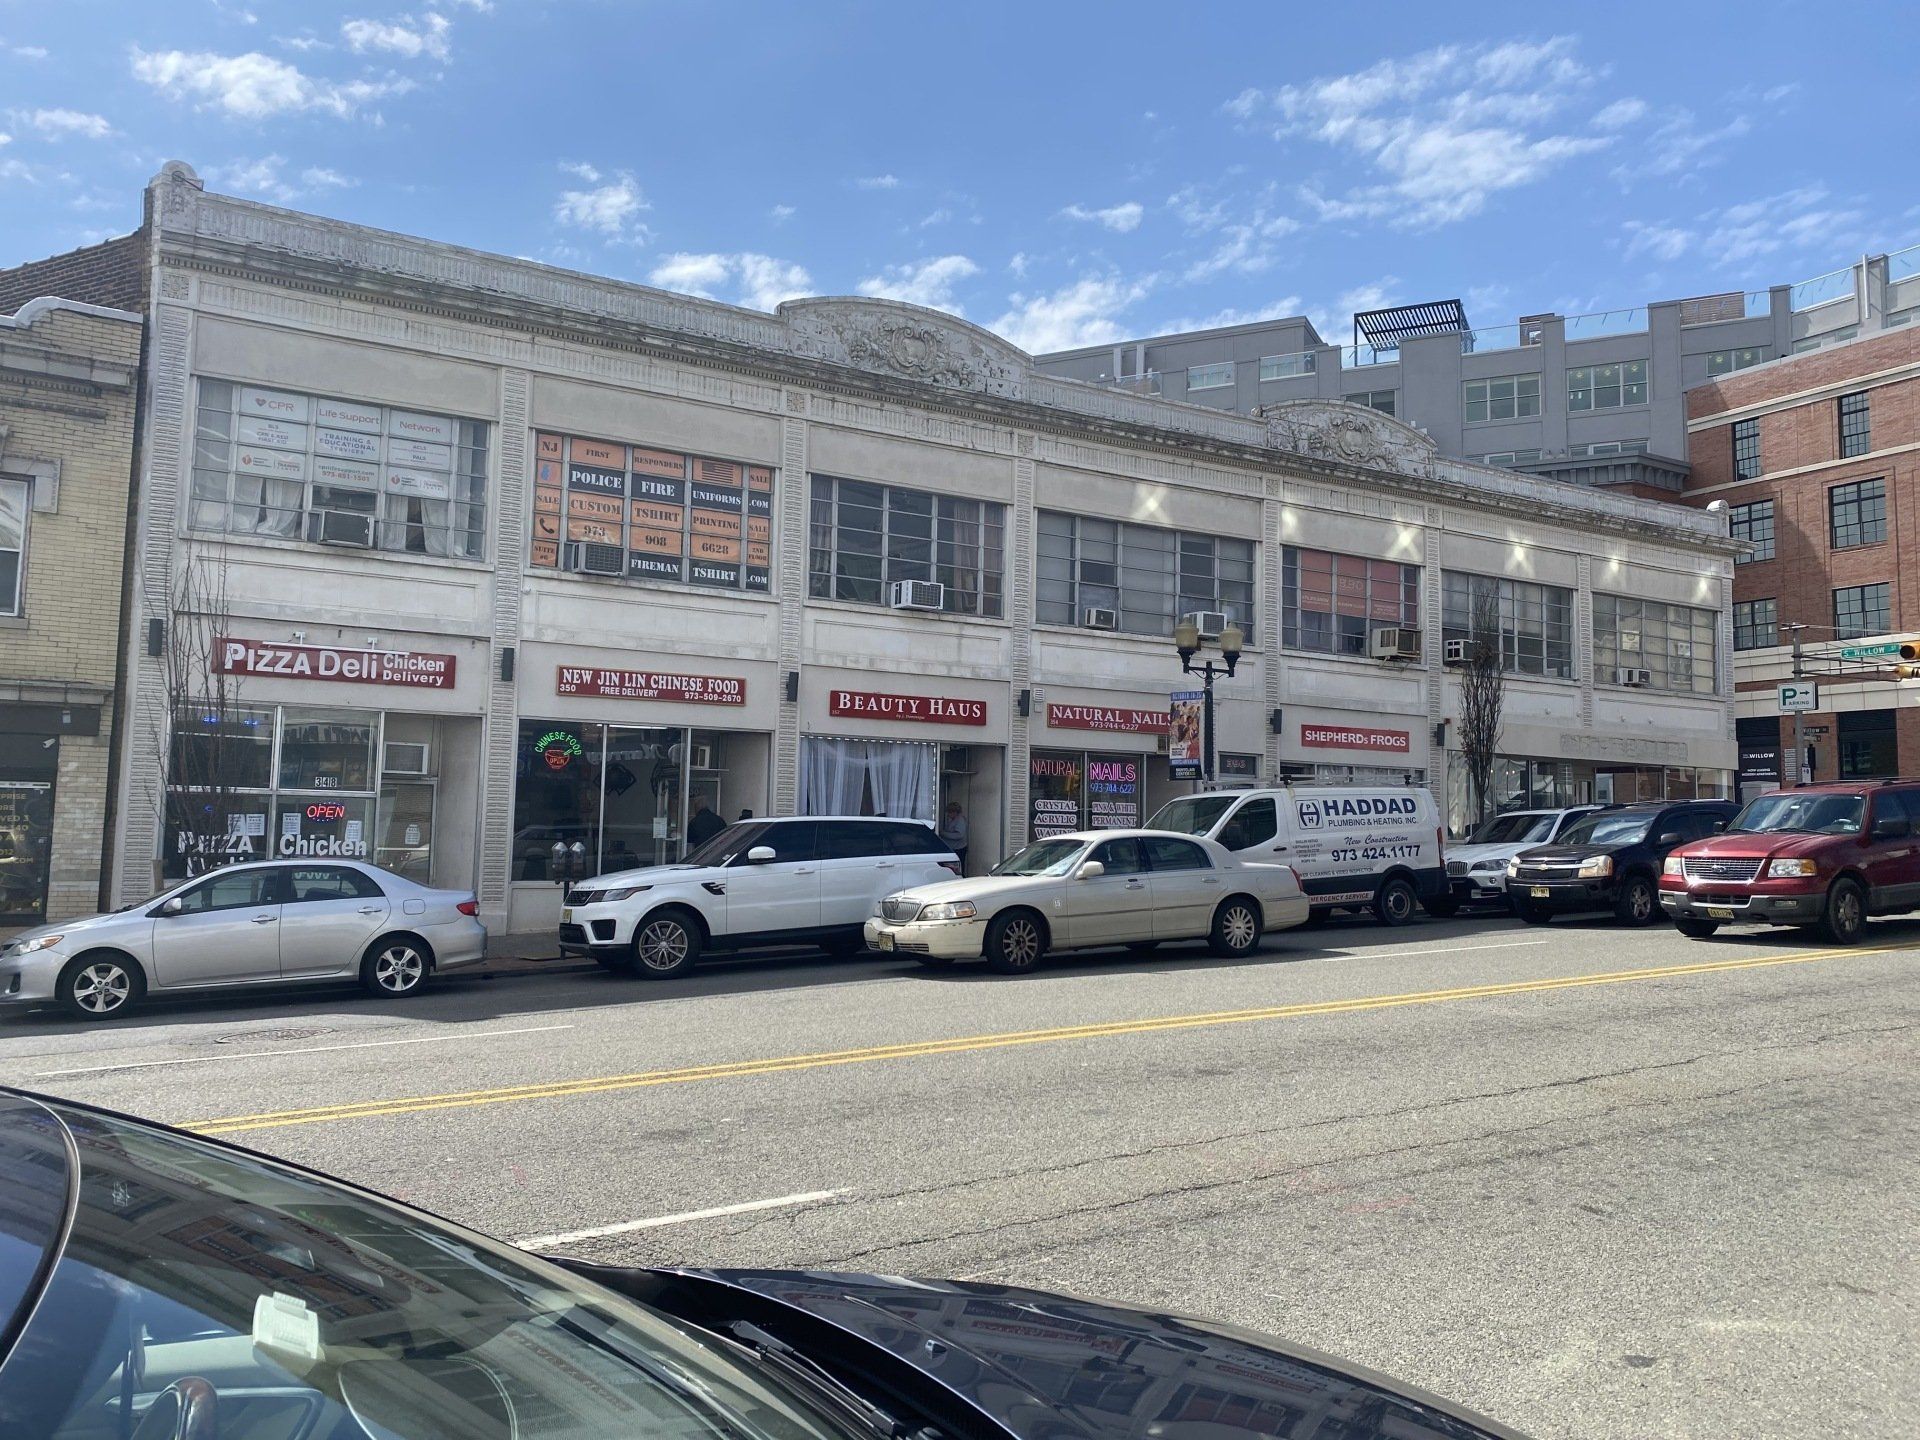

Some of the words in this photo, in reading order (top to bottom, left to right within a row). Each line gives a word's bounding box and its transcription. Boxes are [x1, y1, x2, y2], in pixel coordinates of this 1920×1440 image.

[268, 400, 295, 412] CPR
[319, 408, 338, 418] Life
[339, 411, 380, 425] Support
[399, 421, 442, 434] Network
[319, 438, 376, 452] EDUCATIONAL
[324, 433, 364, 444] TRAINING
[542, 441, 558, 452] NJ
[585, 448, 610, 459] FIRST
[634, 456, 684, 470] RESPONDERS
[571, 470, 622, 489] POLICE
[641, 481, 676, 497] FIRE
[692, 490, 742, 505] UNIFORMS
[748, 499, 769, 509] .COM
[537, 494, 561, 504] SALE
[571, 499, 622, 515] CUSTOM
[635, 507, 680, 523] TSHIRT
[692, 516, 739, 530] PRINTING
[749, 524, 768, 533] SALE
[584, 525, 606, 537] 973
[645, 534, 667, 547] 908
[701, 542, 729, 555] 6628
[631, 558, 680, 574] FIREMAN
[692, 567, 737, 581] TSHIRT
[1854, 647, 1885, 656] WILLOW
[224, 643, 312, 675] PIZZA
[318, 650, 377, 679] Deli
[383, 653, 445, 672] Chicken
[382, 669, 444, 686] Delivery
[562, 669, 593, 684] NEW
[597, 671, 620, 687] JIN
[625, 674, 647, 689] LIN
[650, 675, 704, 691] CHINESE
[708, 679, 739, 694] FOOD
[559, 684, 577, 692] 350
[600, 686, 620, 696] FREE
[622, 687, 659, 697] DELIVERY
[684, 691, 742, 703] 973-509-2670
[1782, 688, 1798, 706] P
[838, 692, 920, 714] BEAUTY
[928, 699, 981, 718] HAUS
[1052, 705, 1124, 723] NATURAL
[1089, 720, 1139, 731] 973-744-6227
[534, 731, 566, 753] CHINESE
[565, 734, 582, 755] FOOD
[1305, 730, 1369, 745] SHEPHERDs
[1370, 735, 1406, 746] FROGS
[1032, 760, 1077, 776] NATURAL
[1089, 762, 1136, 782] NAILS
[315, 776, 337, 788] 348
[1090, 783, 1136, 794] 973-744-6227
[307, 804, 345, 818] OPEN
[1035, 800, 1077, 811] CRYSTAL
[1116, 803, 1136, 813] WHITE
[1322, 798, 1417, 817] HADDAD
[1034, 814, 1076, 825] ACRYLIC
[1092, 816, 1137, 826] PERMANENT
[1328, 819, 1366, 828] PLUMBING
[1367, 818, 1373, 826] &
[279, 833, 367, 856] Chicken
[1344, 836, 1361, 845] New
[1364, 834, 1409, 845] Construction
[1331, 849, 1358, 862] 973
[1362, 845, 1421, 860] 424.1177
[1310, 894, 1344, 903] MERGENCY
